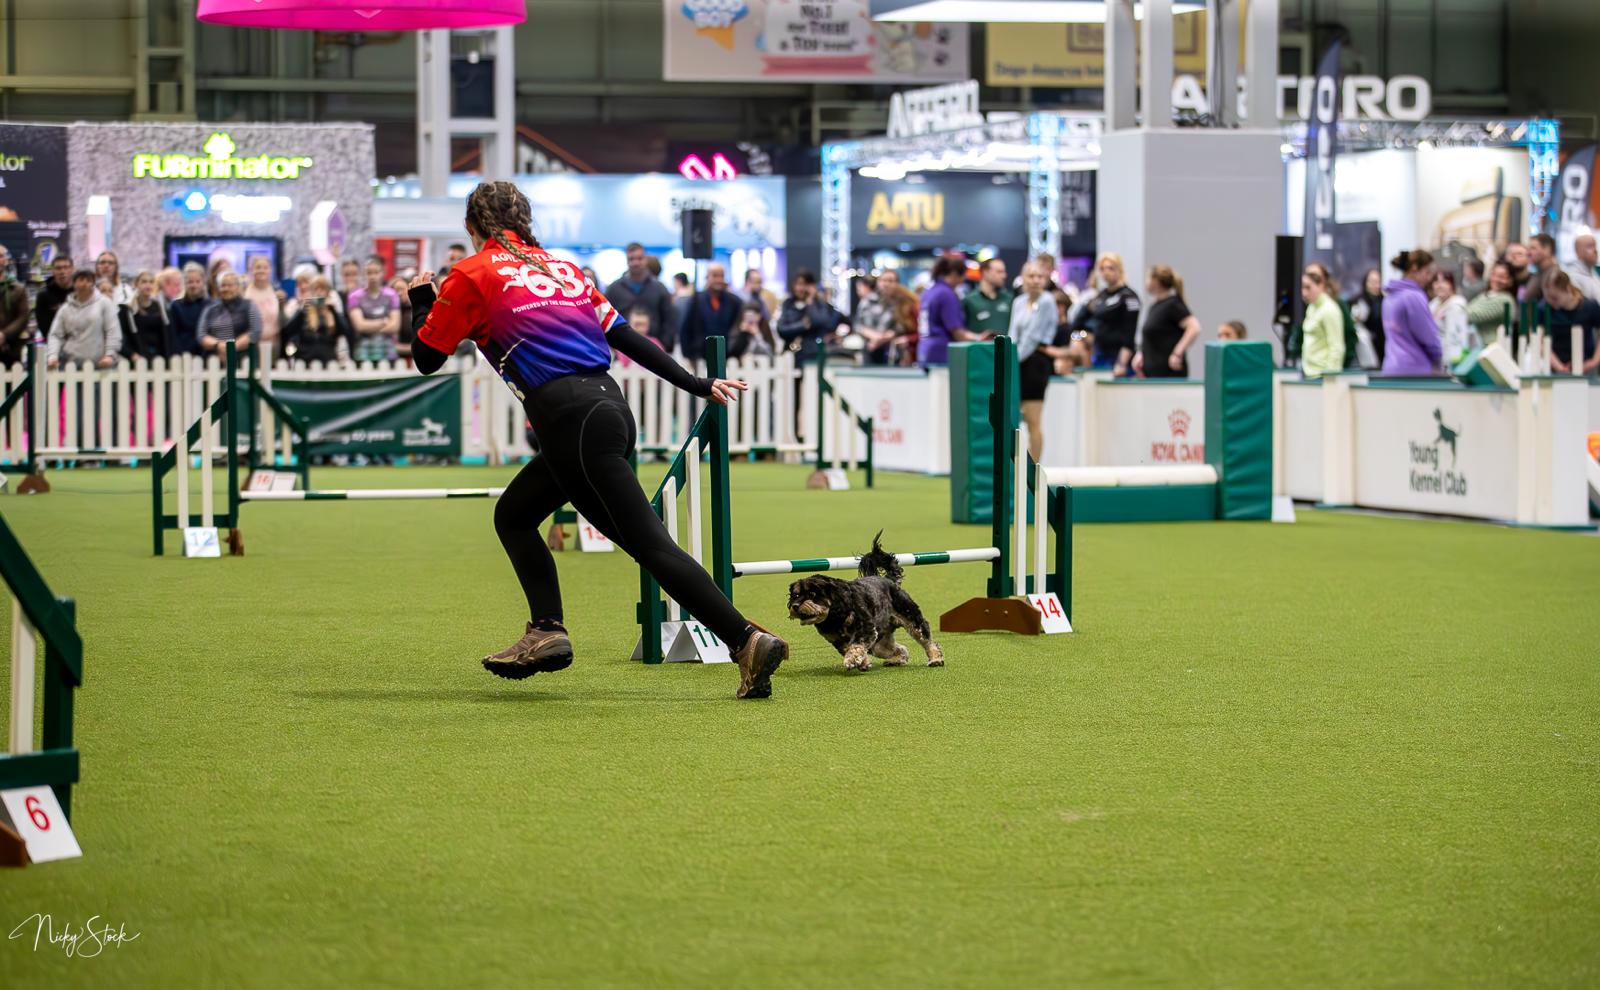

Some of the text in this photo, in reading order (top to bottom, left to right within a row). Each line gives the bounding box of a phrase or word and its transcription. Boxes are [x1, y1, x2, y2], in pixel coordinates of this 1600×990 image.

[133, 153, 304, 180] FURminator
[512, 302, 541, 314] POWERED
[541, 300, 549, 309] BY
[1408, 440, 1438, 471] Young
[1409, 469, 1467, 496] Kennel Club
[190, 531, 214, 547] 12
[1036, 597, 1061, 619] 14
[24, 795, 51, 832] 6
